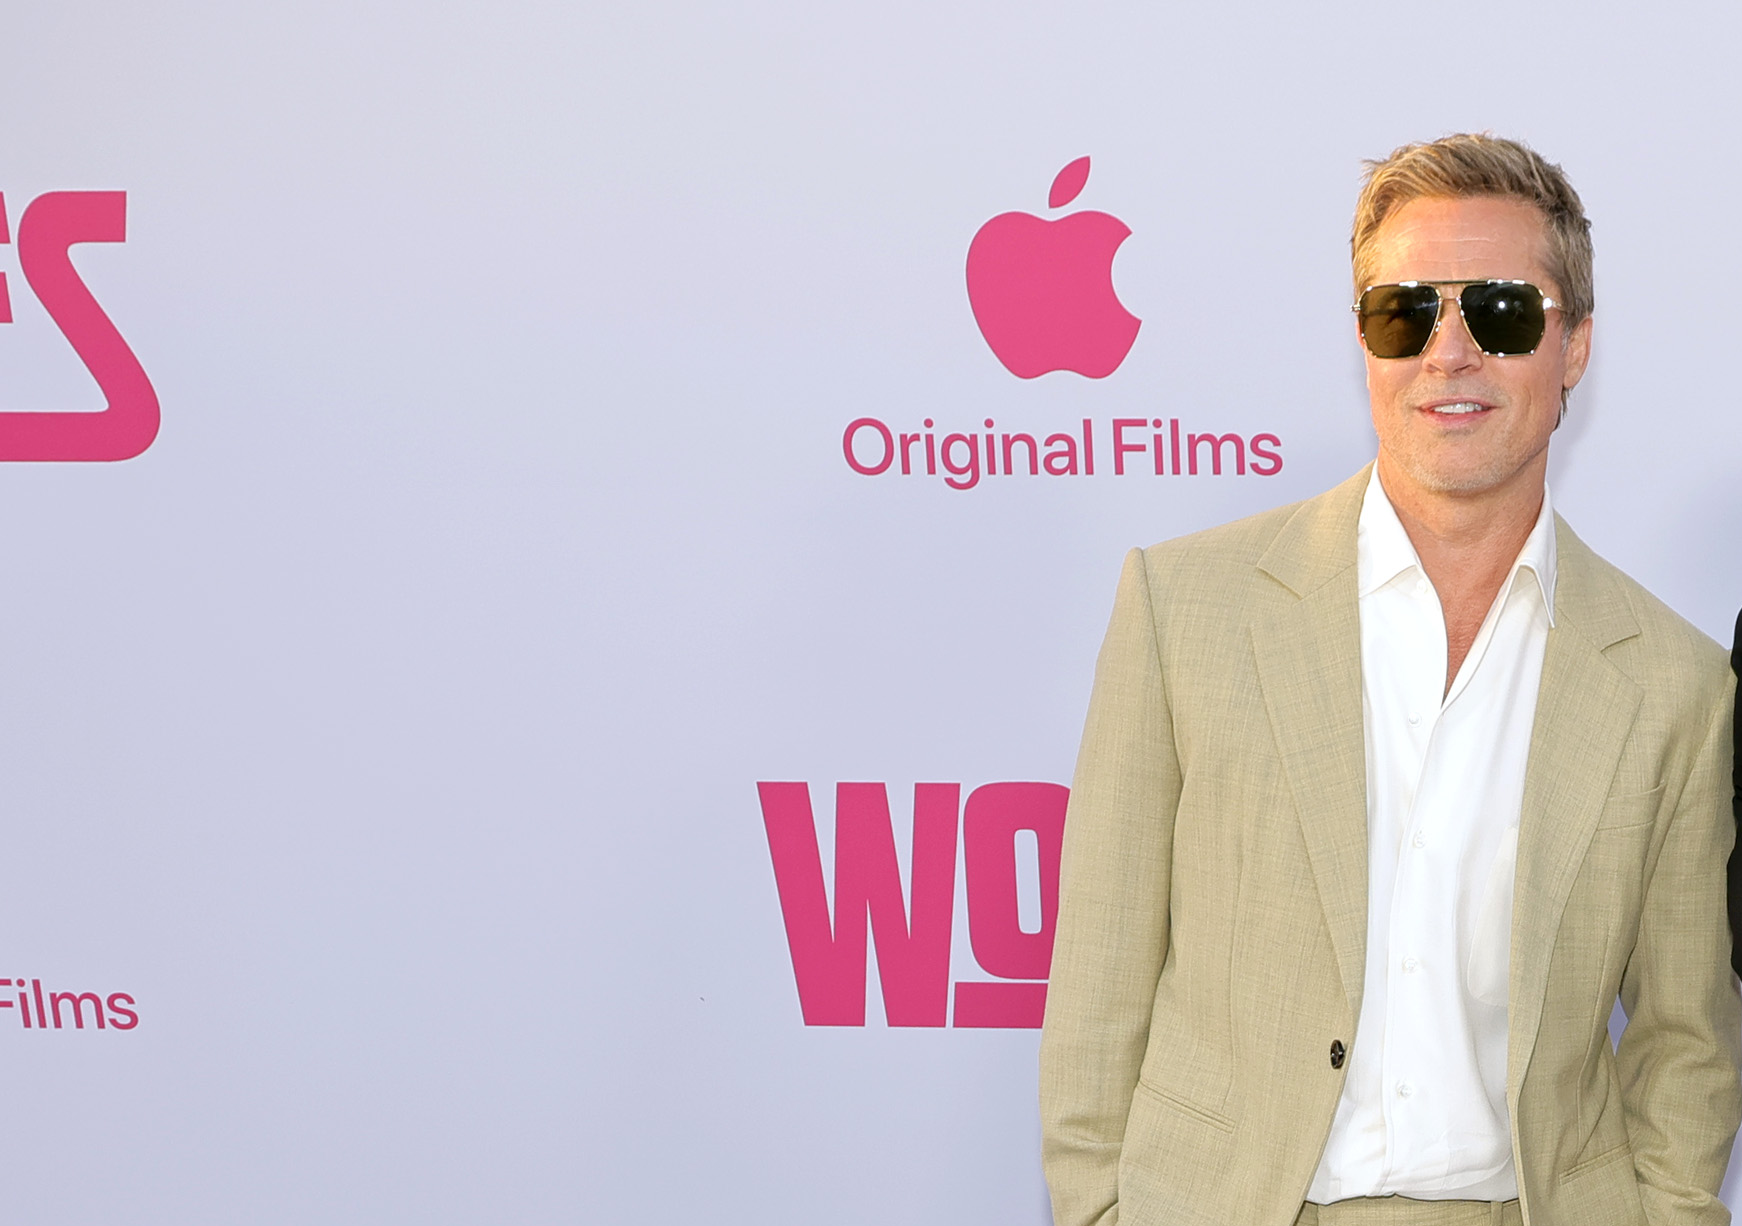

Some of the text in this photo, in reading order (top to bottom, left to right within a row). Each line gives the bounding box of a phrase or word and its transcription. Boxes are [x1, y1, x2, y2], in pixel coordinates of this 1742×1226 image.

[0, 190, 161, 463] S
[842, 417, 1284, 490] Original Films
